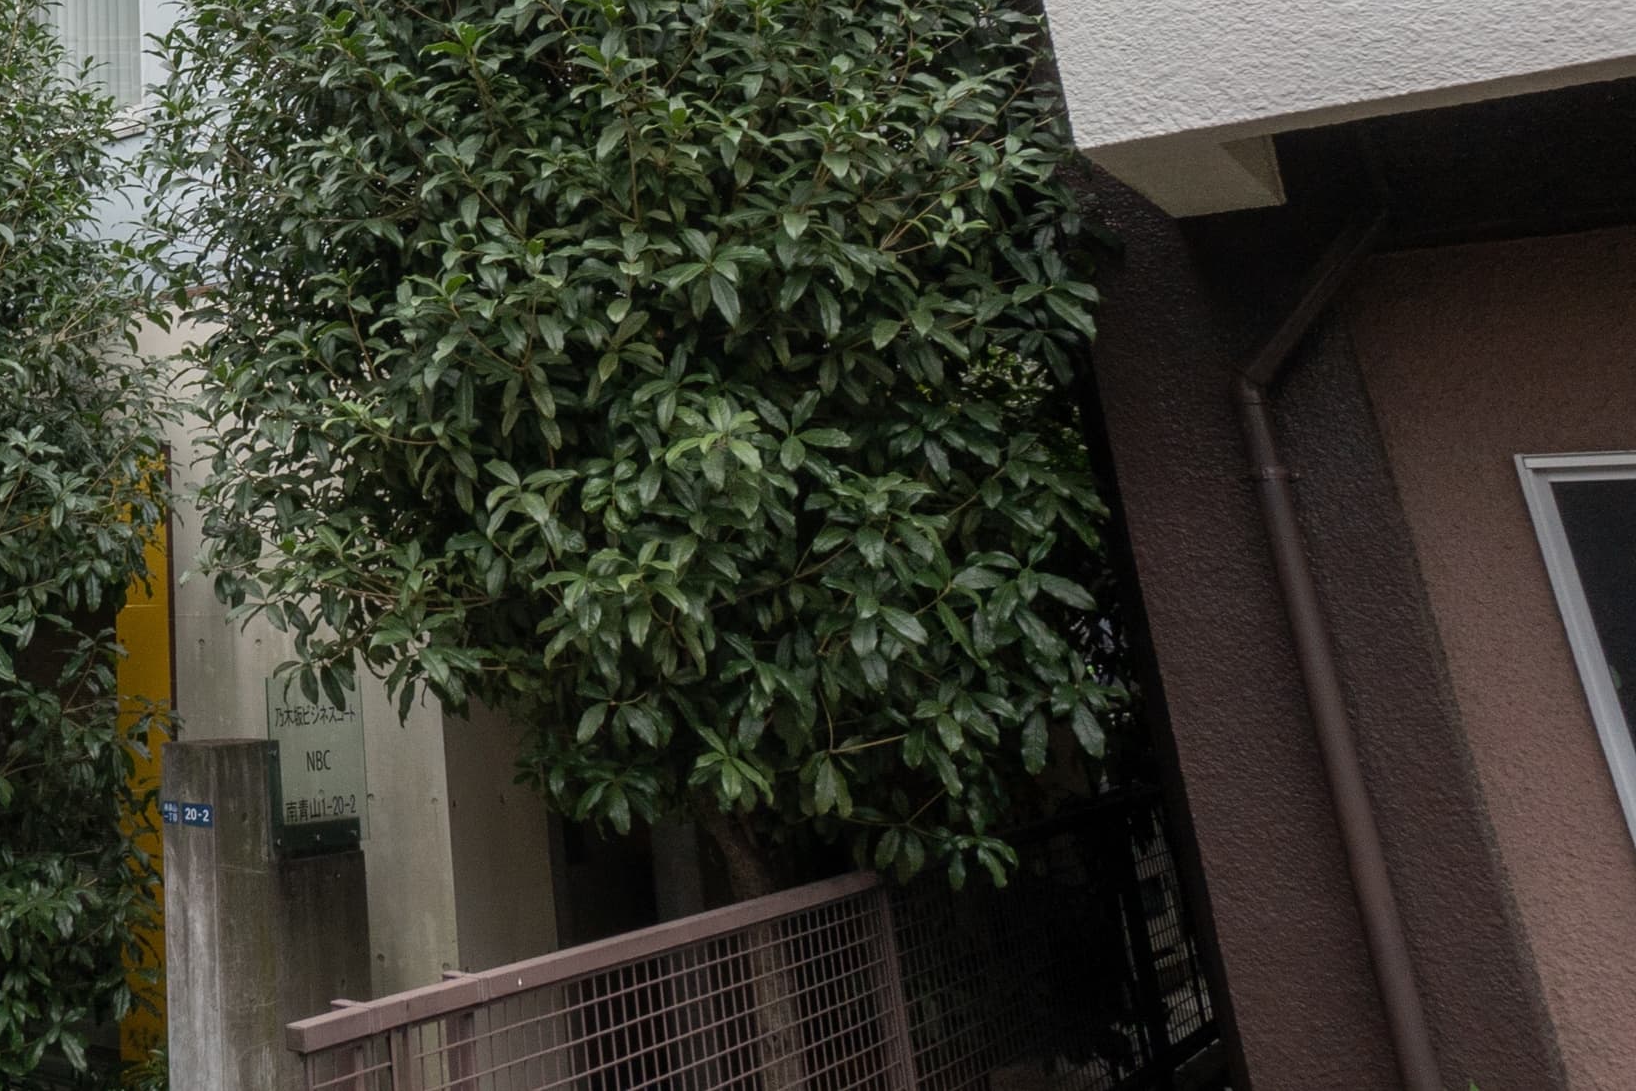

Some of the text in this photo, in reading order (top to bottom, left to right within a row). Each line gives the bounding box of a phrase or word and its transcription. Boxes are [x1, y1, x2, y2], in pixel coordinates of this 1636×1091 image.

[306, 750, 331, 771] NBC
[184, 806, 210, 822] 20-2
[285, 794, 356, 822] 南青山1-20-2
